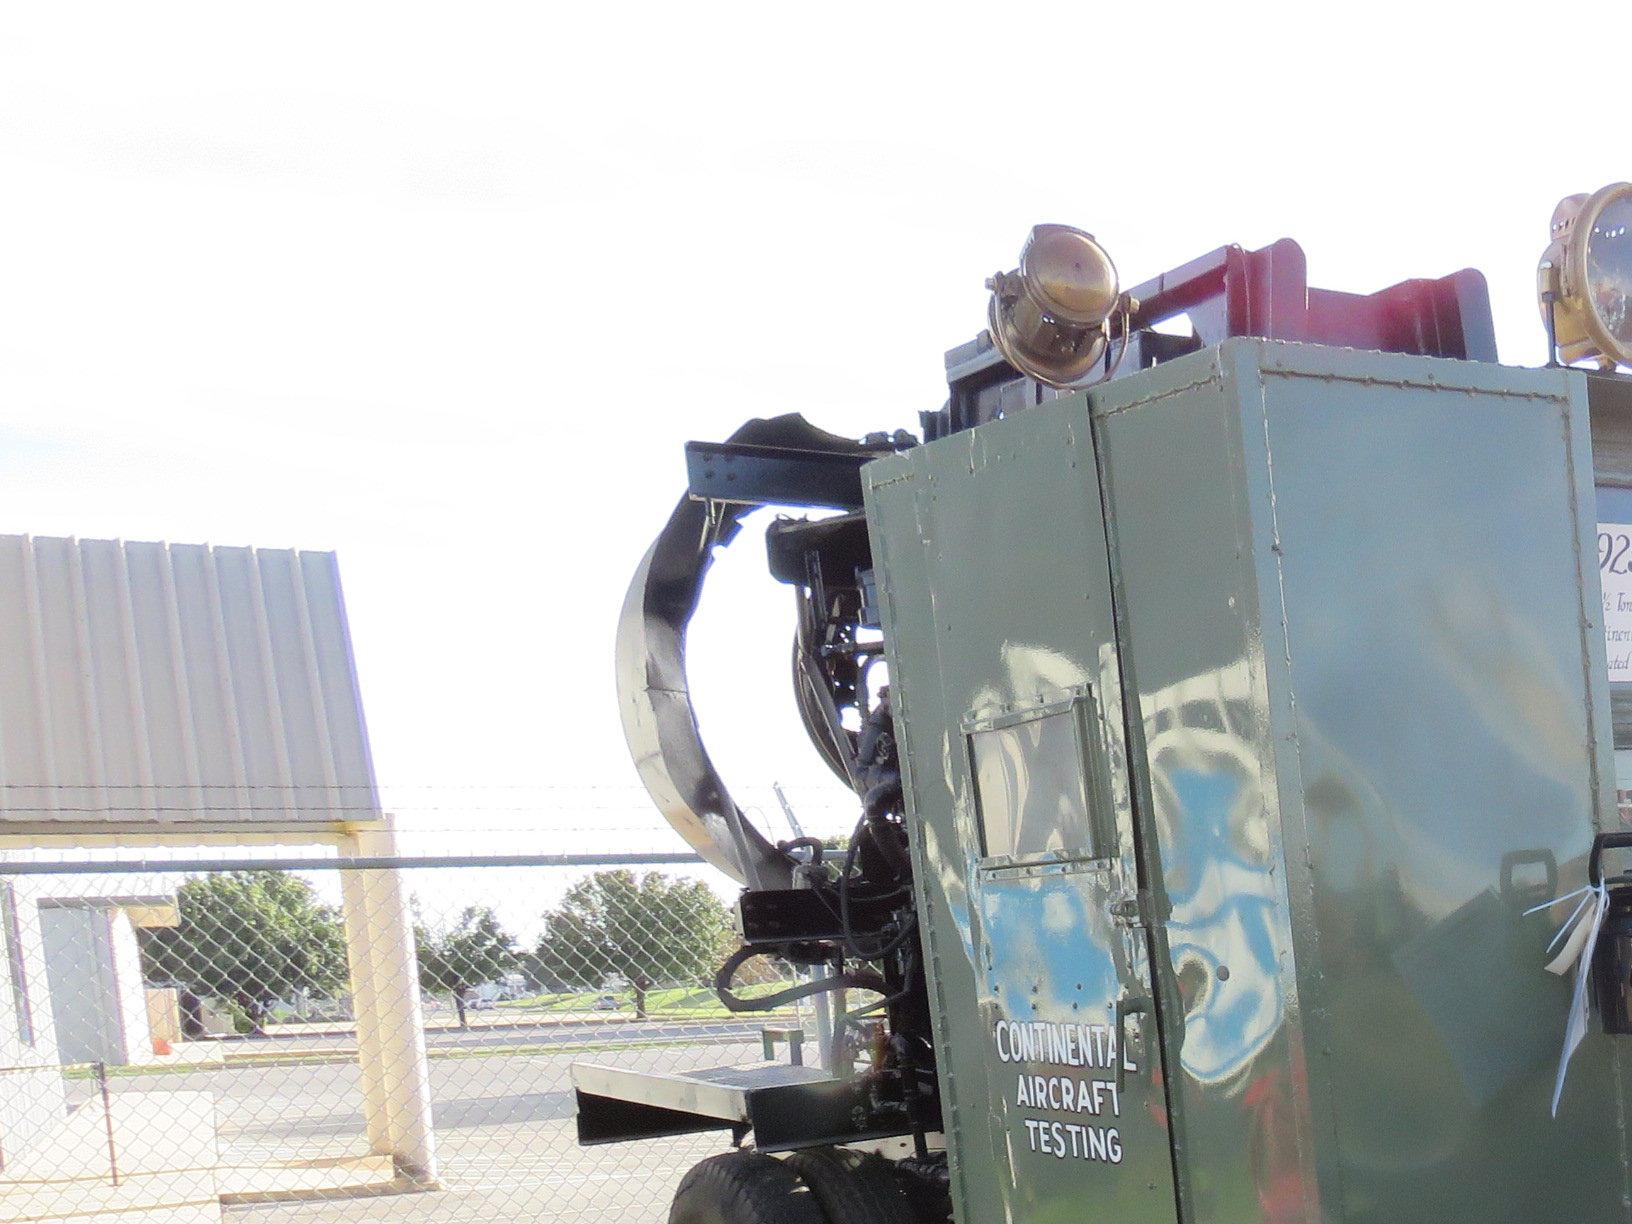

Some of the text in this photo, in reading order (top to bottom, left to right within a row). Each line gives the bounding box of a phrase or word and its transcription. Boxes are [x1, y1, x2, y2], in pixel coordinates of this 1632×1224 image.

[995, 1019, 1137, 1072] CONTINENTAL
[1016, 1073, 1120, 1117] AIRCRAFT
[1024, 1118, 1123, 1164] TESTING
